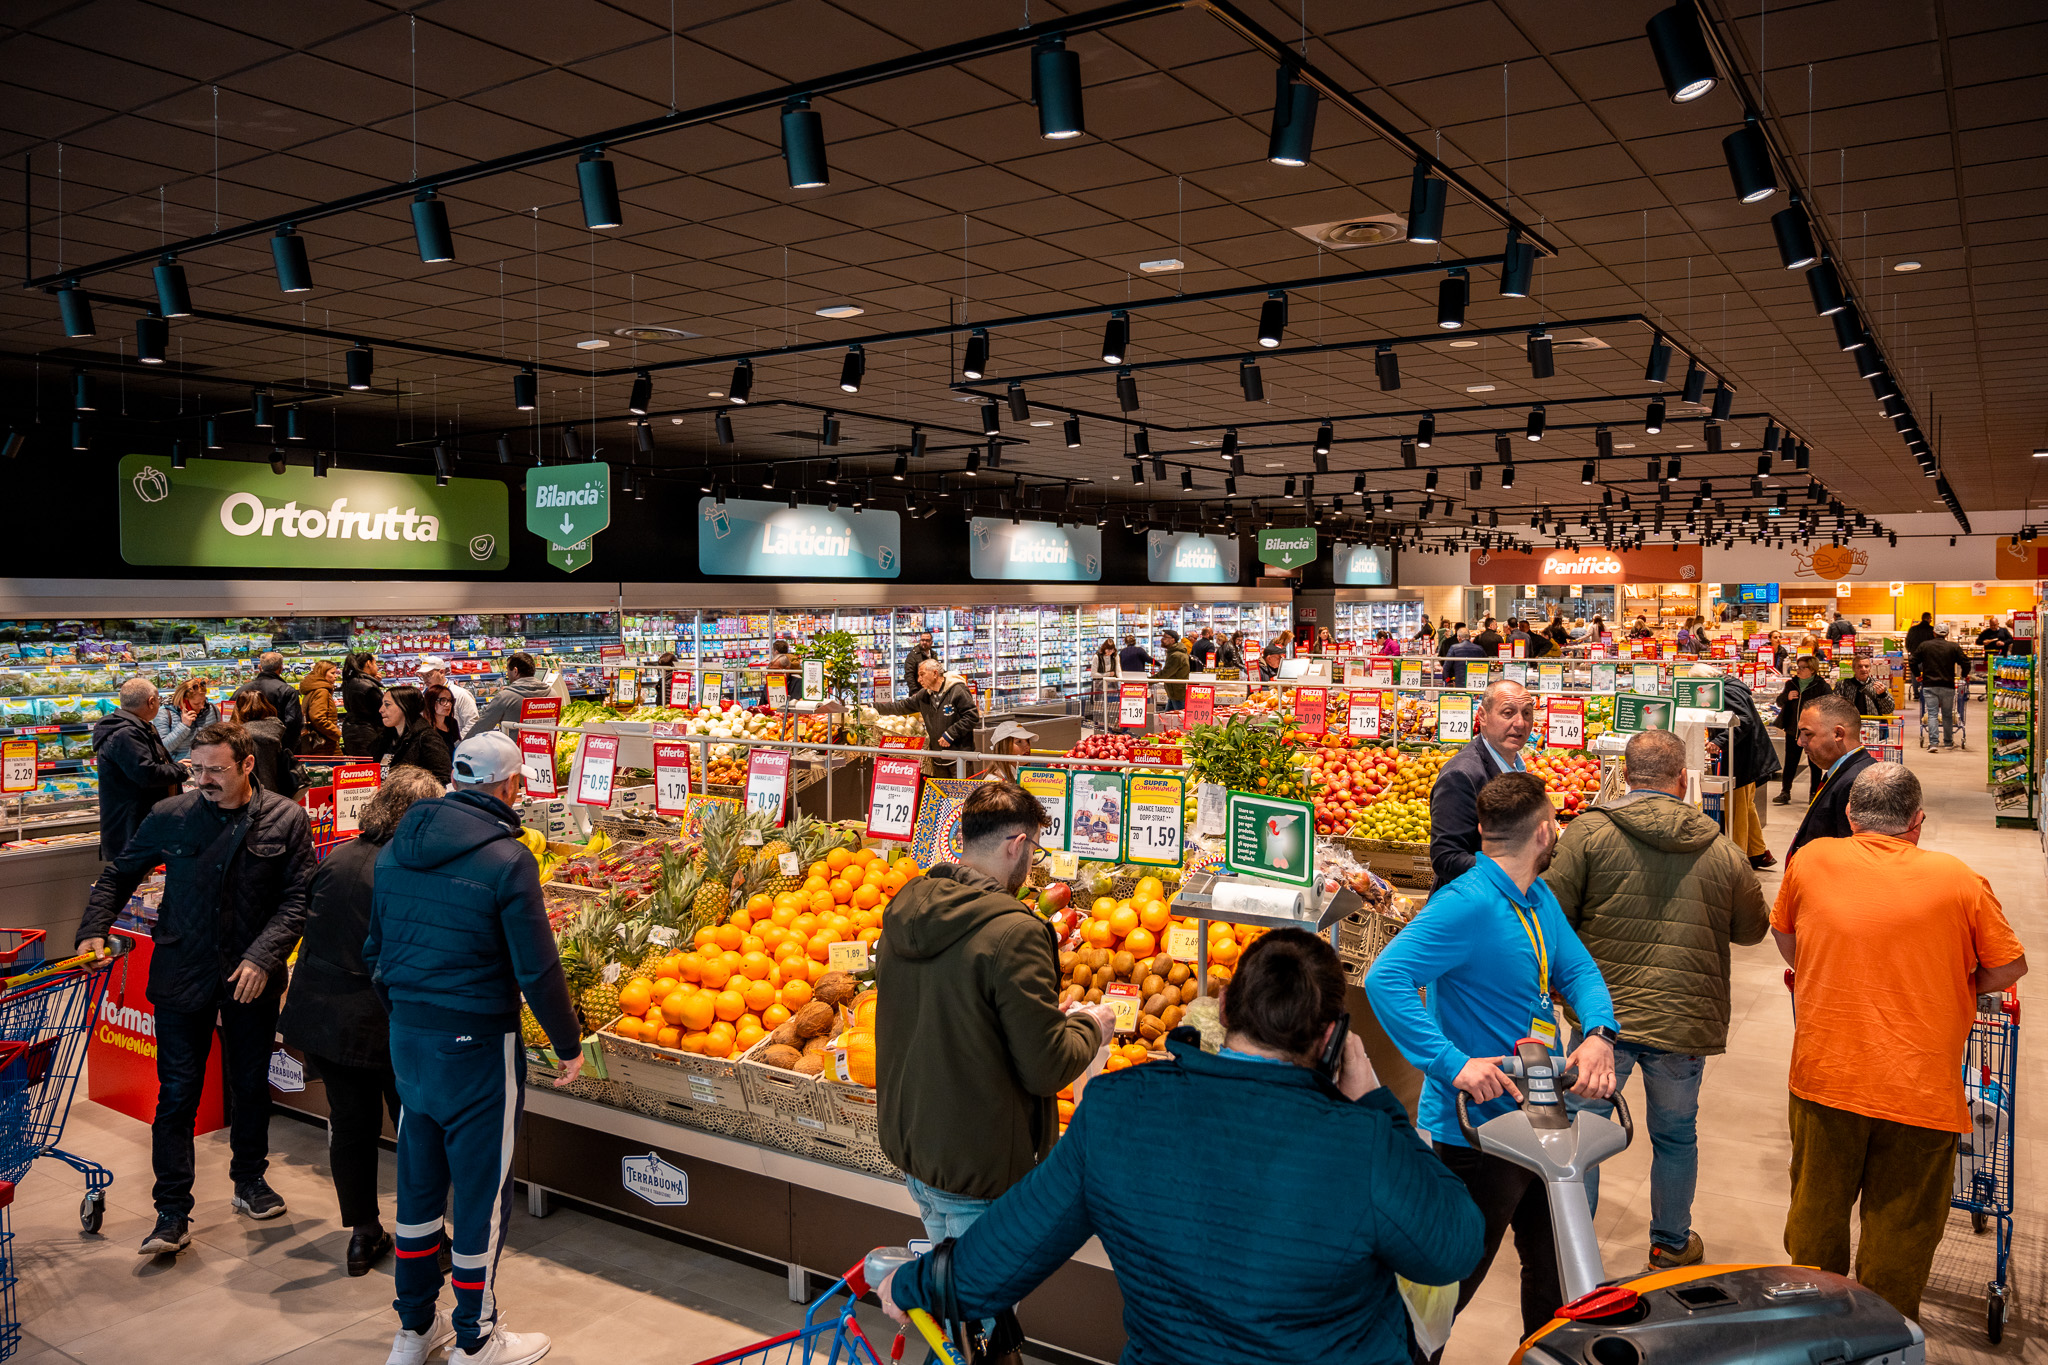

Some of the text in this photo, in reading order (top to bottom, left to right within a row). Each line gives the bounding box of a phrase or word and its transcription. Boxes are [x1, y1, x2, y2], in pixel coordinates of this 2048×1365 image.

[536, 482, 599, 508] Bilancia
[220, 492, 441, 541] Ortofrutta
[762, 523, 852, 556] Latticini
[1265, 537, 1309, 551] Bilancia
[1010, 538, 1069, 564] Latticini
[1175, 547, 1216, 569] Latticini
[1543, 557, 1621, 574] Panificio
[528, 702, 556, 710] formato
[1560, 726, 1579, 738] 1.49
[525, 735, 547, 746] offerta
[590, 738, 614, 750] offerta
[659, 747, 685, 758] offerta
[755, 753, 784, 766] offerta
[340, 769, 375, 779] formato
[880, 762, 914, 776] offerta
[590, 774, 609, 791] 0,95
[1023, 776, 1064, 785] Conveniente
[668, 783, 686, 800] 1,79
[1134, 785, 1179, 793] Conveniente
[759, 792, 781, 810] 0,99
[885, 803, 910, 823] 1,29
[1154, 806, 1175, 814] TAROCCO
[1146, 825, 1176, 848] 1,59
[846, 948, 860, 959] 1,89
[28, 963, 57, 977] SUPER
[100, 1025, 157, 1060] Convenien
[456, 1035, 472, 1043] FILA
[269, 1065, 302, 1083] ERRABUONA
[626, 1166, 684, 1196] TERRABUONA
